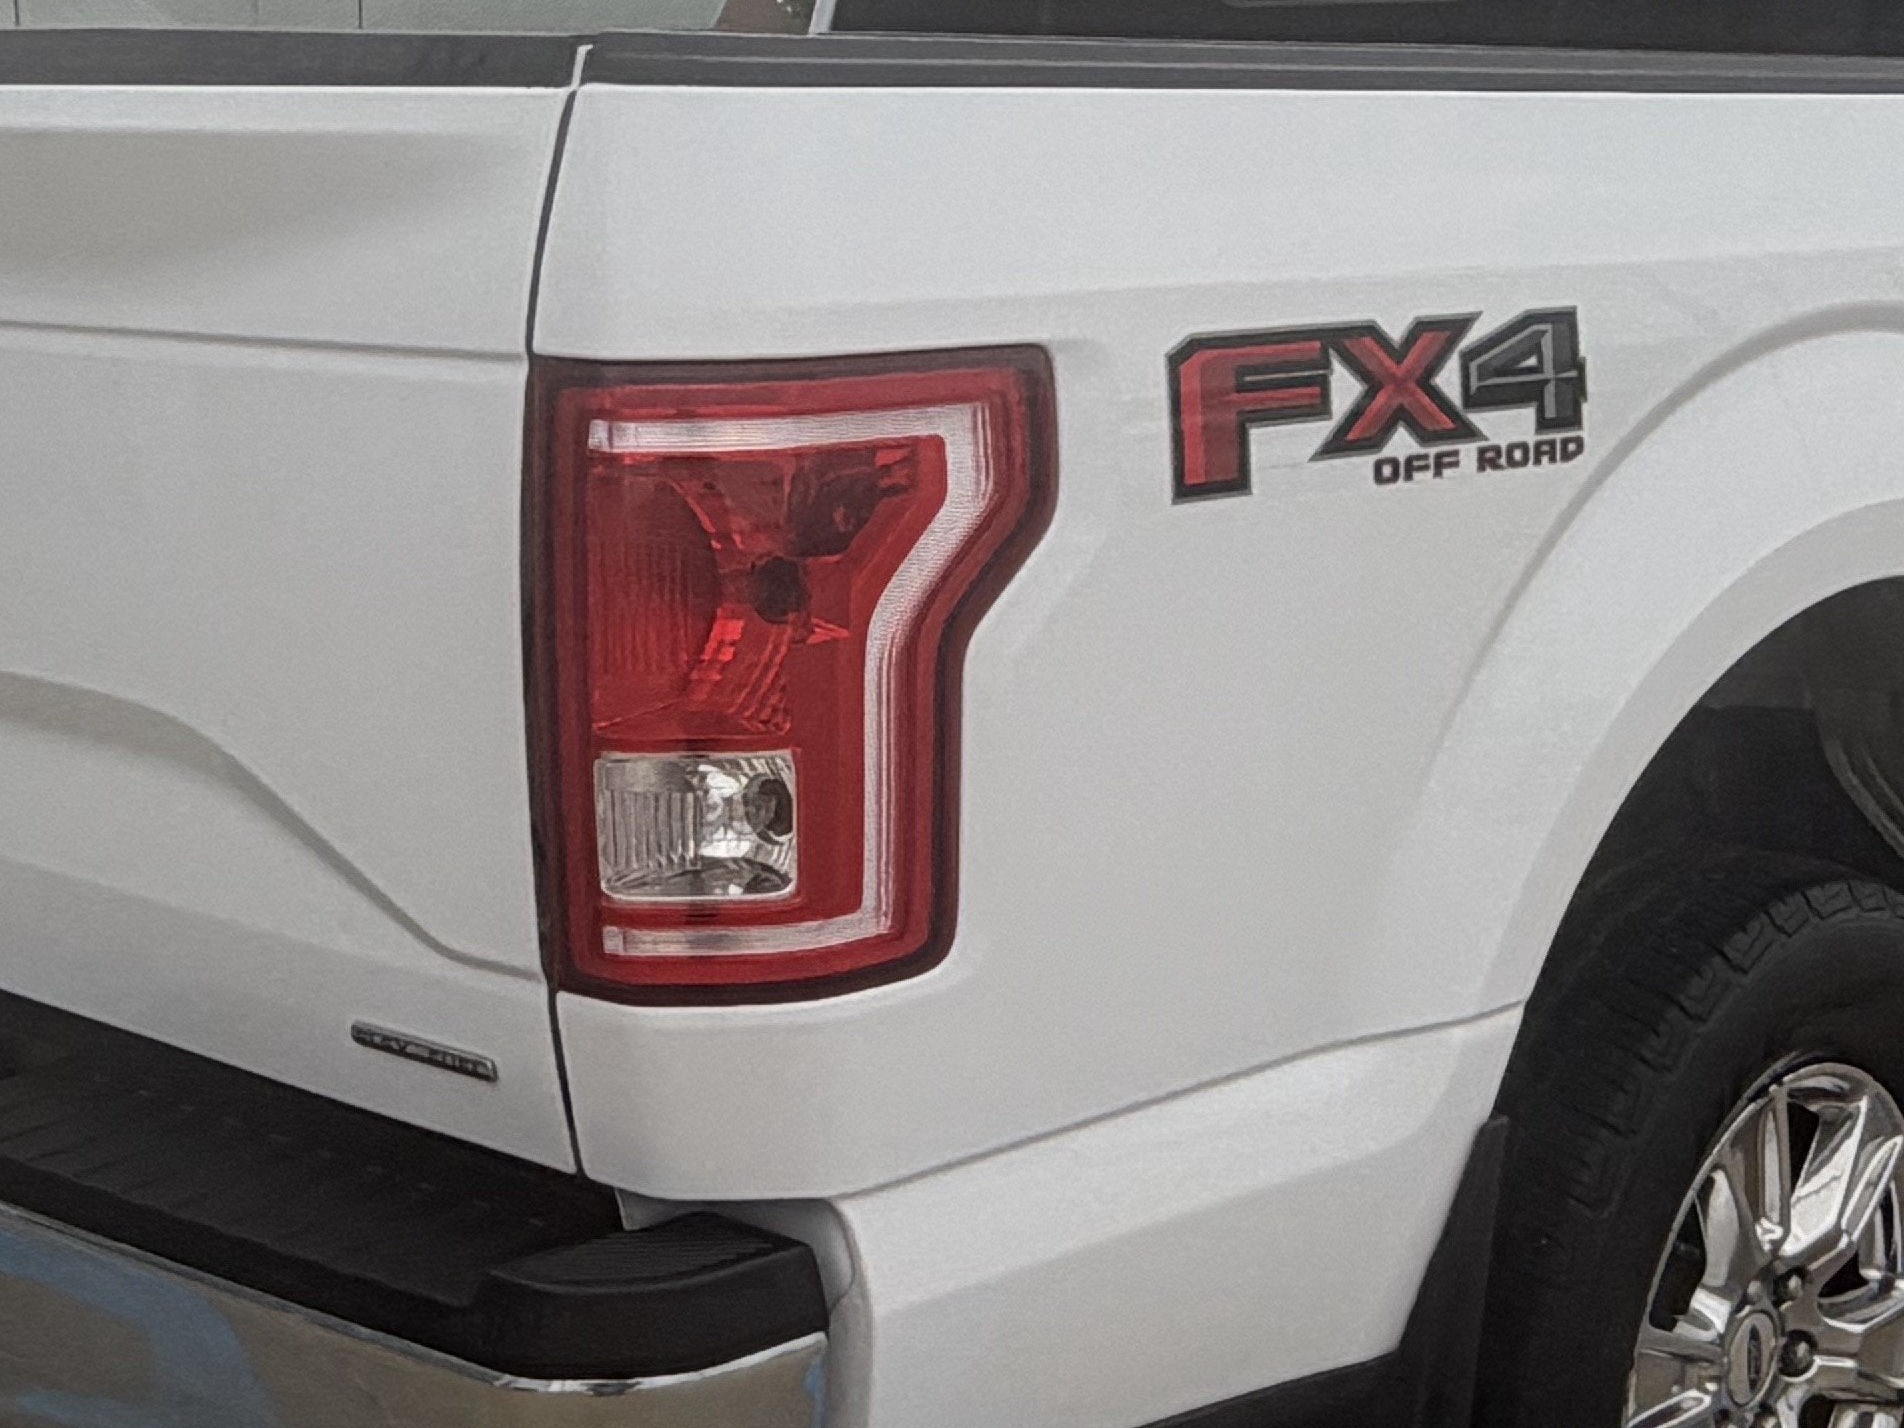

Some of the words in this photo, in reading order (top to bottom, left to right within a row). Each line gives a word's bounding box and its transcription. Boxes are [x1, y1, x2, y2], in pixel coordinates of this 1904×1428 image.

[1165, 305, 1587, 505] FX4
[1373, 450, 1461, 486] OFF
[1476, 435, 1586, 474] ROAD
